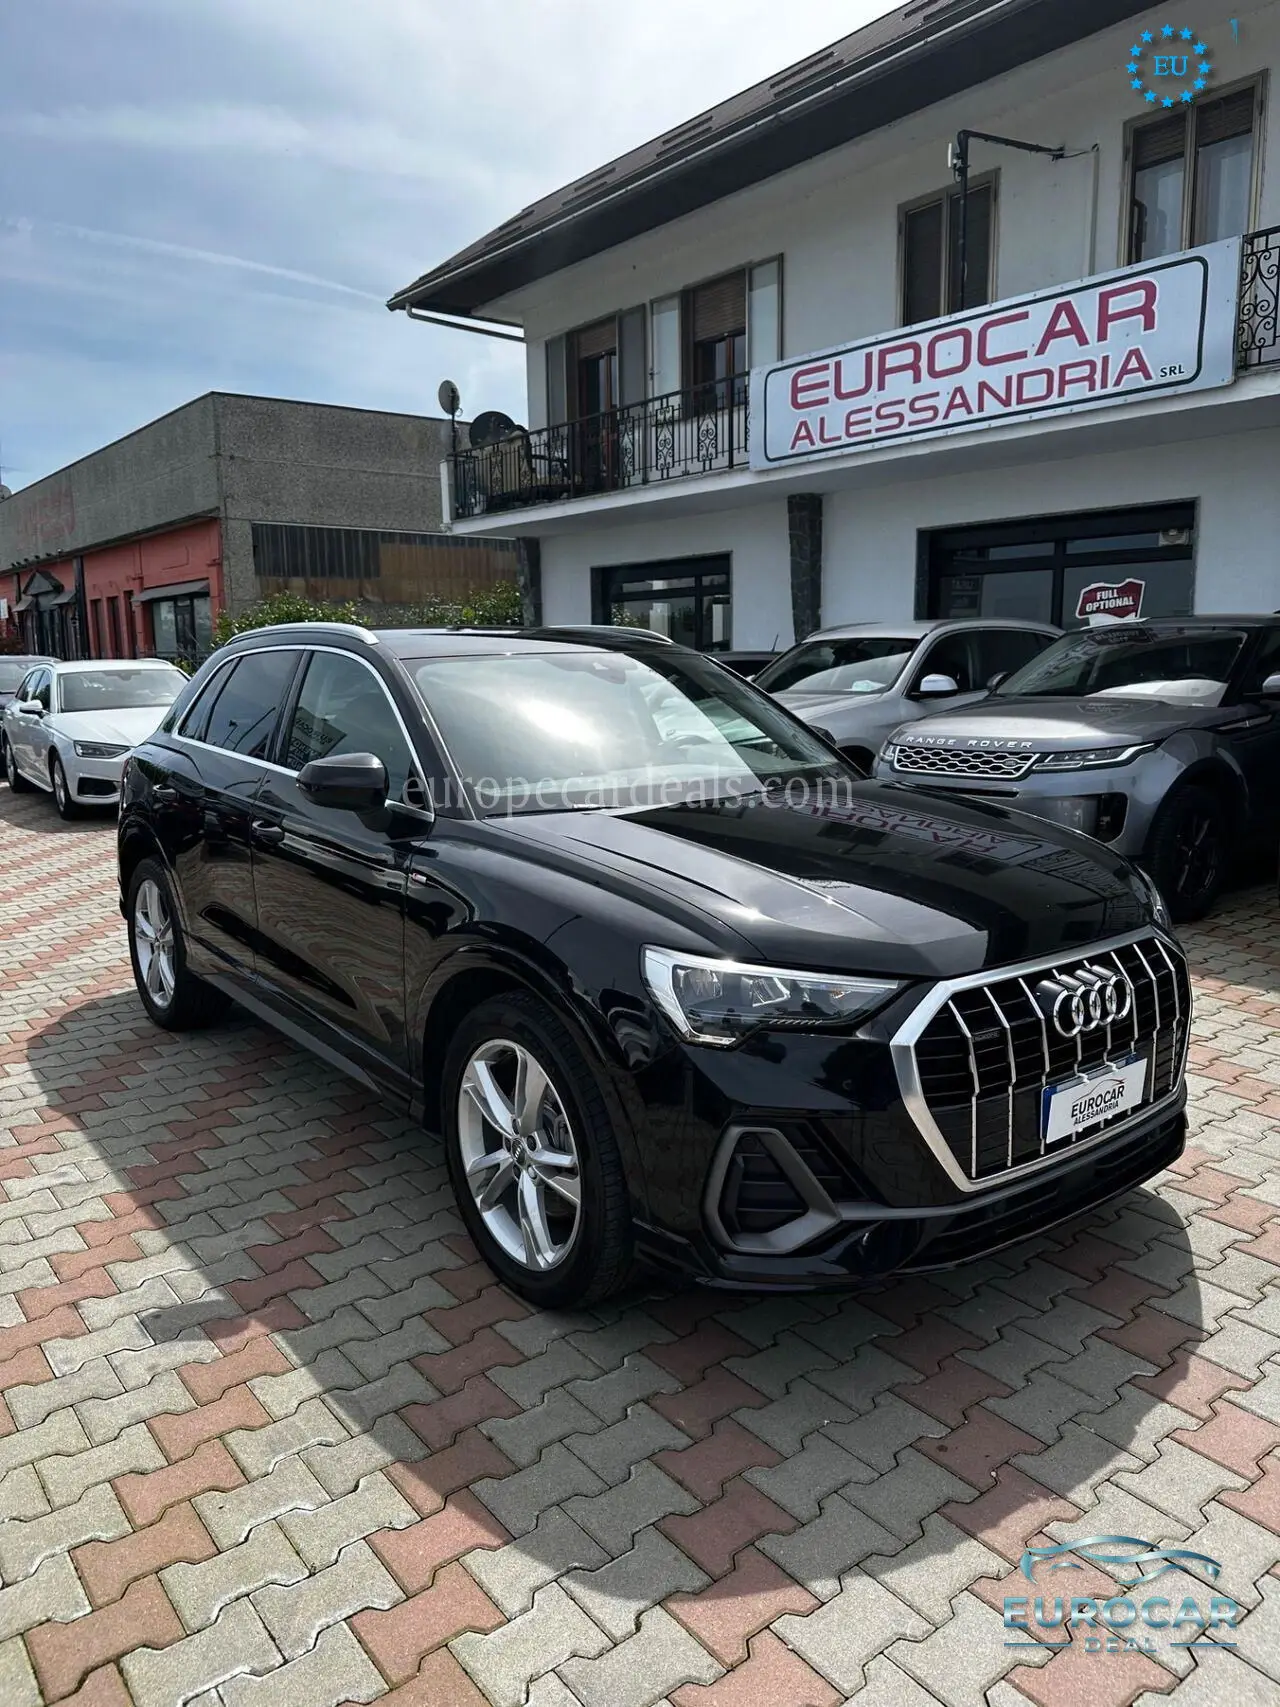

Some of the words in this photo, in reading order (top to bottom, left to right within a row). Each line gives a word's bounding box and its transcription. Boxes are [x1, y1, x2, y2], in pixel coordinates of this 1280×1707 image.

[790, 280, 1157, 410] EUROCAR
[789, 347, 1153, 451] ALESSANDRIA
[1159, 364, 1185, 379] SRL
[1086, 597, 1134, 612] OPTIONAL
[1096, 588, 1119, 601] FULL
[906, 736, 957, 746] RANGE
[967, 739, 1033, 749] ROVER
[1071, 1085, 1125, 1118] EUROCAR
[1074, 1101, 1119, 1125] ALESSANDRIA
